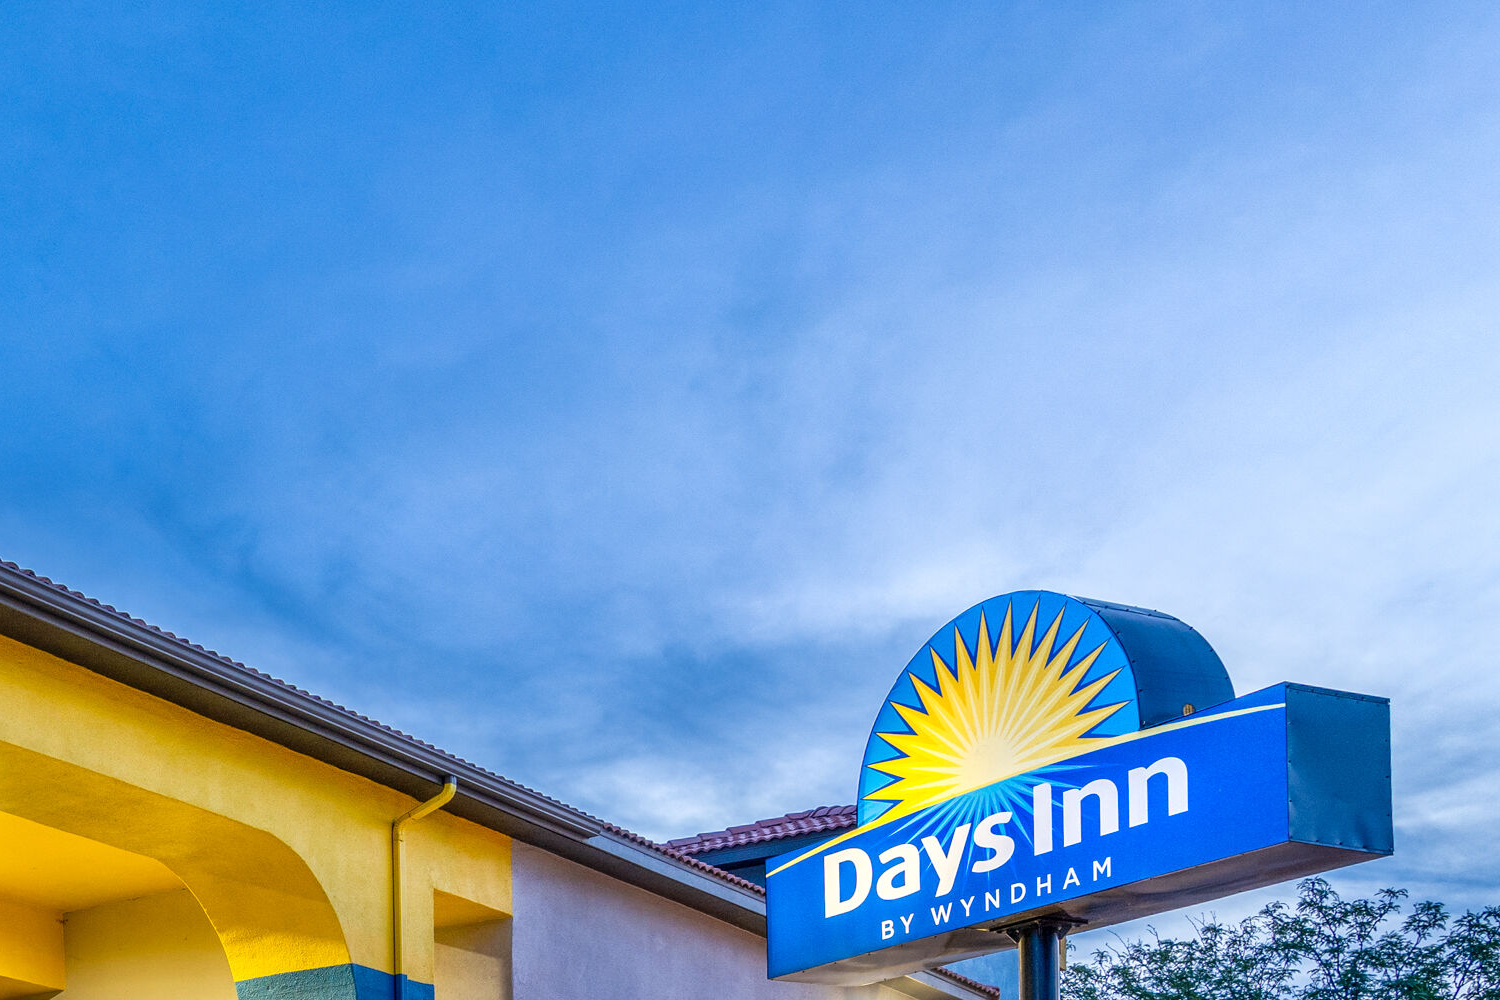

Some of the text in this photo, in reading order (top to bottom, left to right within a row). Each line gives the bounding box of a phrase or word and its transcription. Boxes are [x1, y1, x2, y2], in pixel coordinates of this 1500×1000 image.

[824, 756, 1189, 919] Days Inn
[880, 857, 1112, 941] BY WYNDHAM
